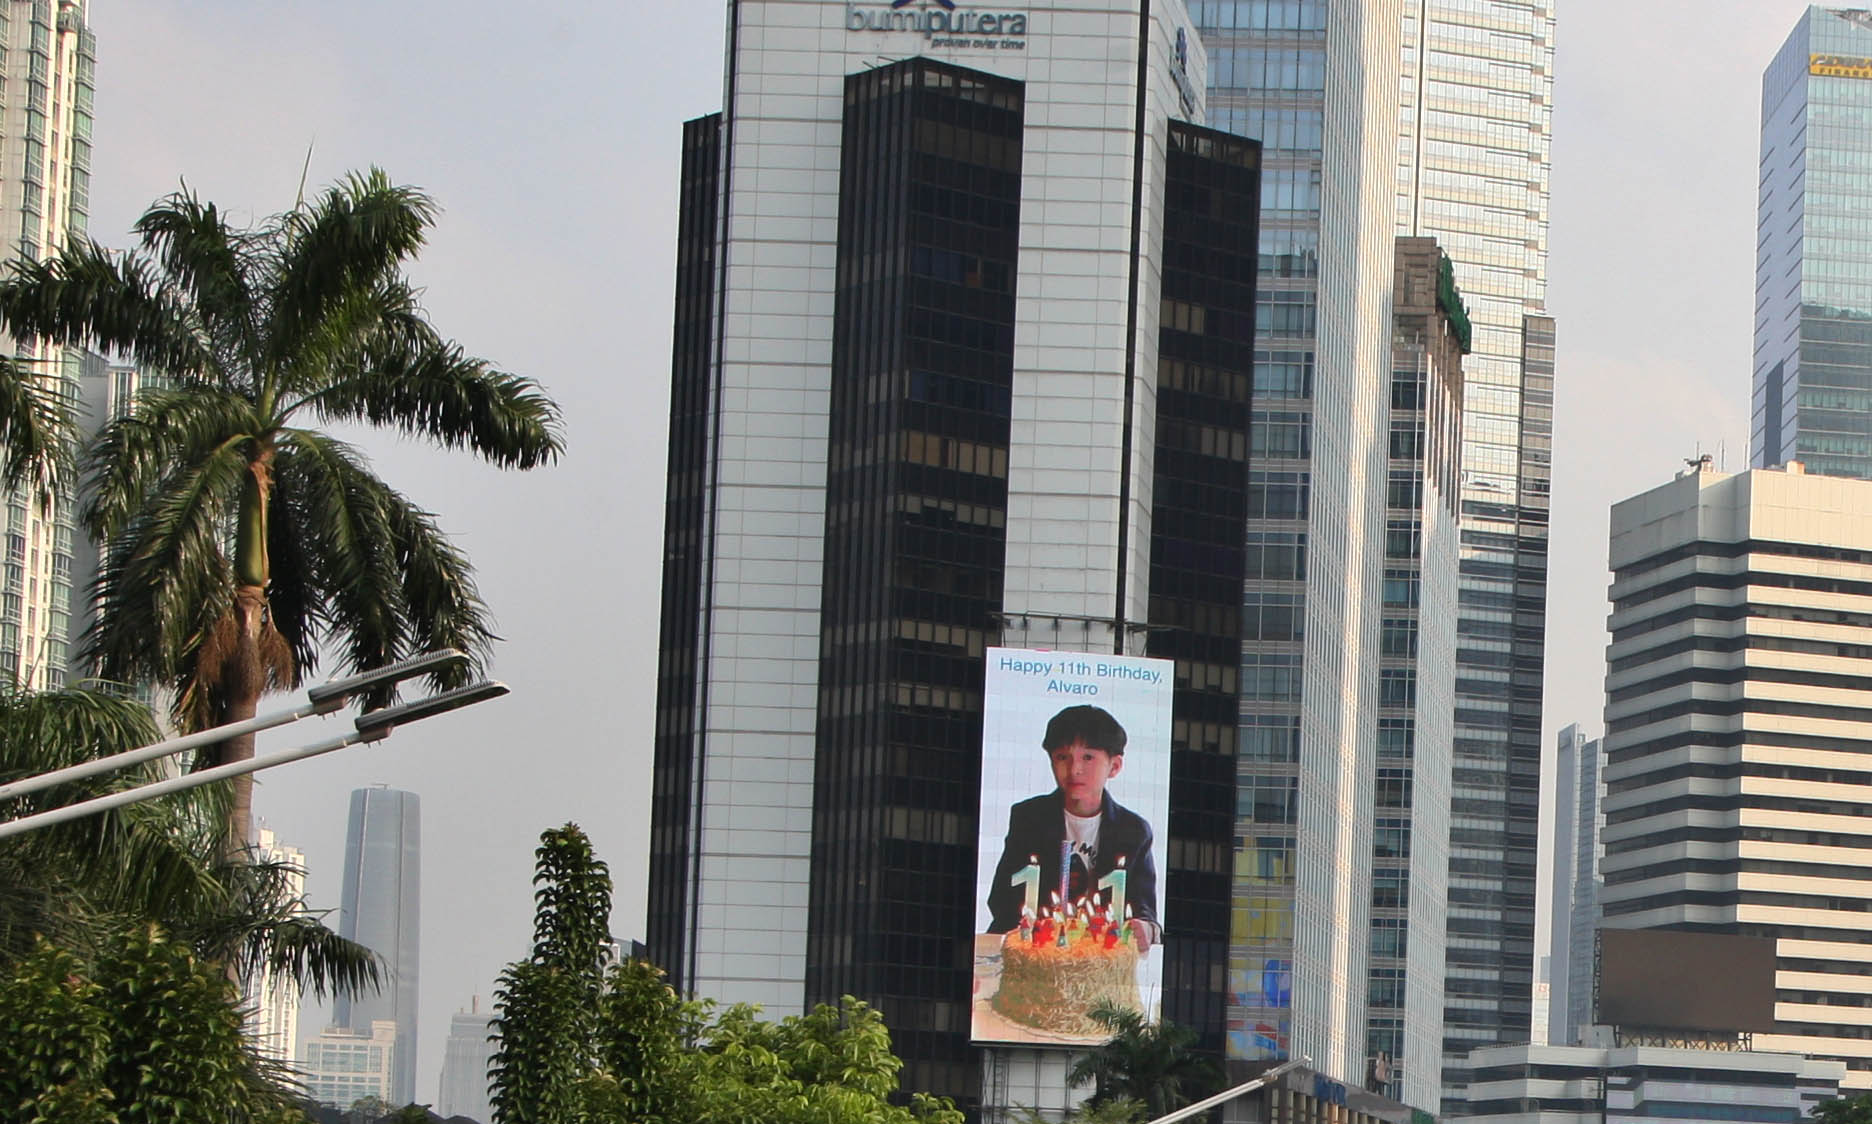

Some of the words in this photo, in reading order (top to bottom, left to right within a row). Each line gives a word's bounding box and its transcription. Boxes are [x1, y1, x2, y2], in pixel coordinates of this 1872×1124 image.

[848, 5, 1027, 39] bumiputera
[931, 38, 970, 49] proven
[974, 39, 999, 49] over
[1001, 39, 1026, 50] time
[1000, 657, 1052, 676] Happy
[1059, 662, 1091, 676] 11th
[1097, 664, 1163, 684] Birthday,
[1047, 680, 1098, 696] Alvaro
